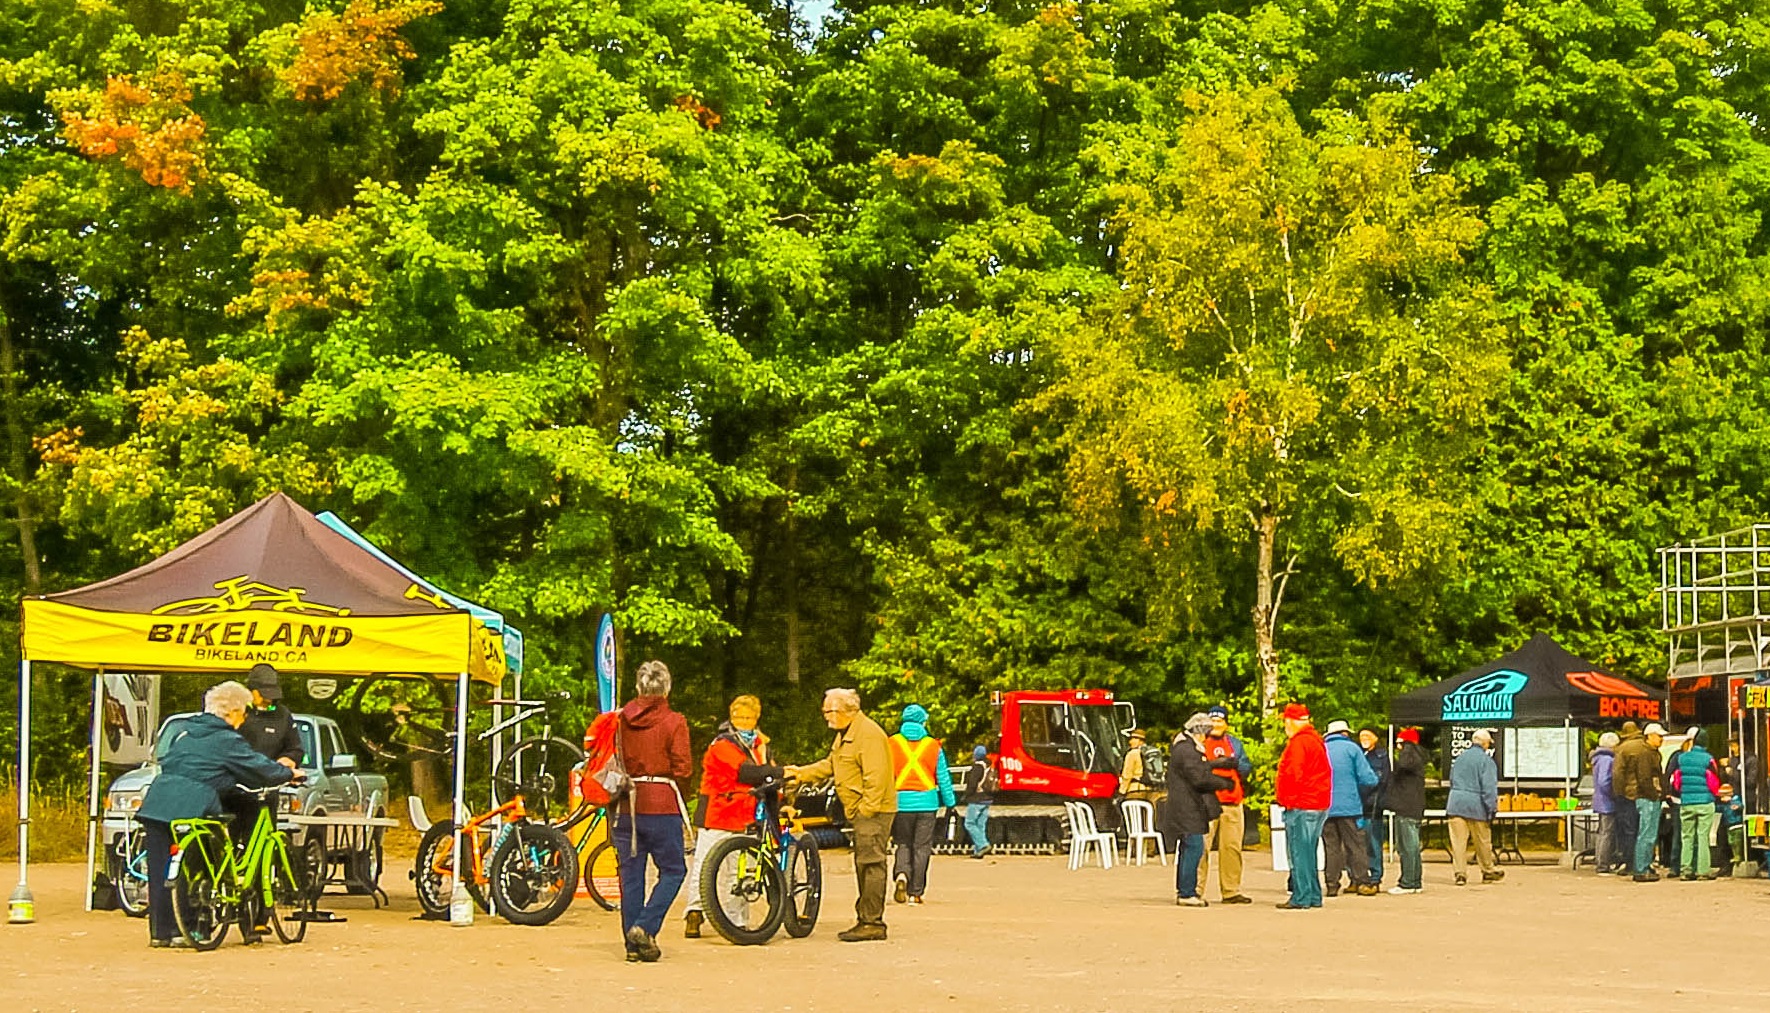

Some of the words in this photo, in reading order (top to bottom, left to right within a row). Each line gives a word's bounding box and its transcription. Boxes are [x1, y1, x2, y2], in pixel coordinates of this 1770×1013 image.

[147, 621, 353, 648] BIKELAND
[195, 649, 308, 663] BIKELAND.CA
[1443, 693, 1513, 712] SALOMON
[1599, 696, 1660, 721] BONFIRE
[1451, 731, 1465, 740] TO
[1000, 756, 1023, 772] 100
